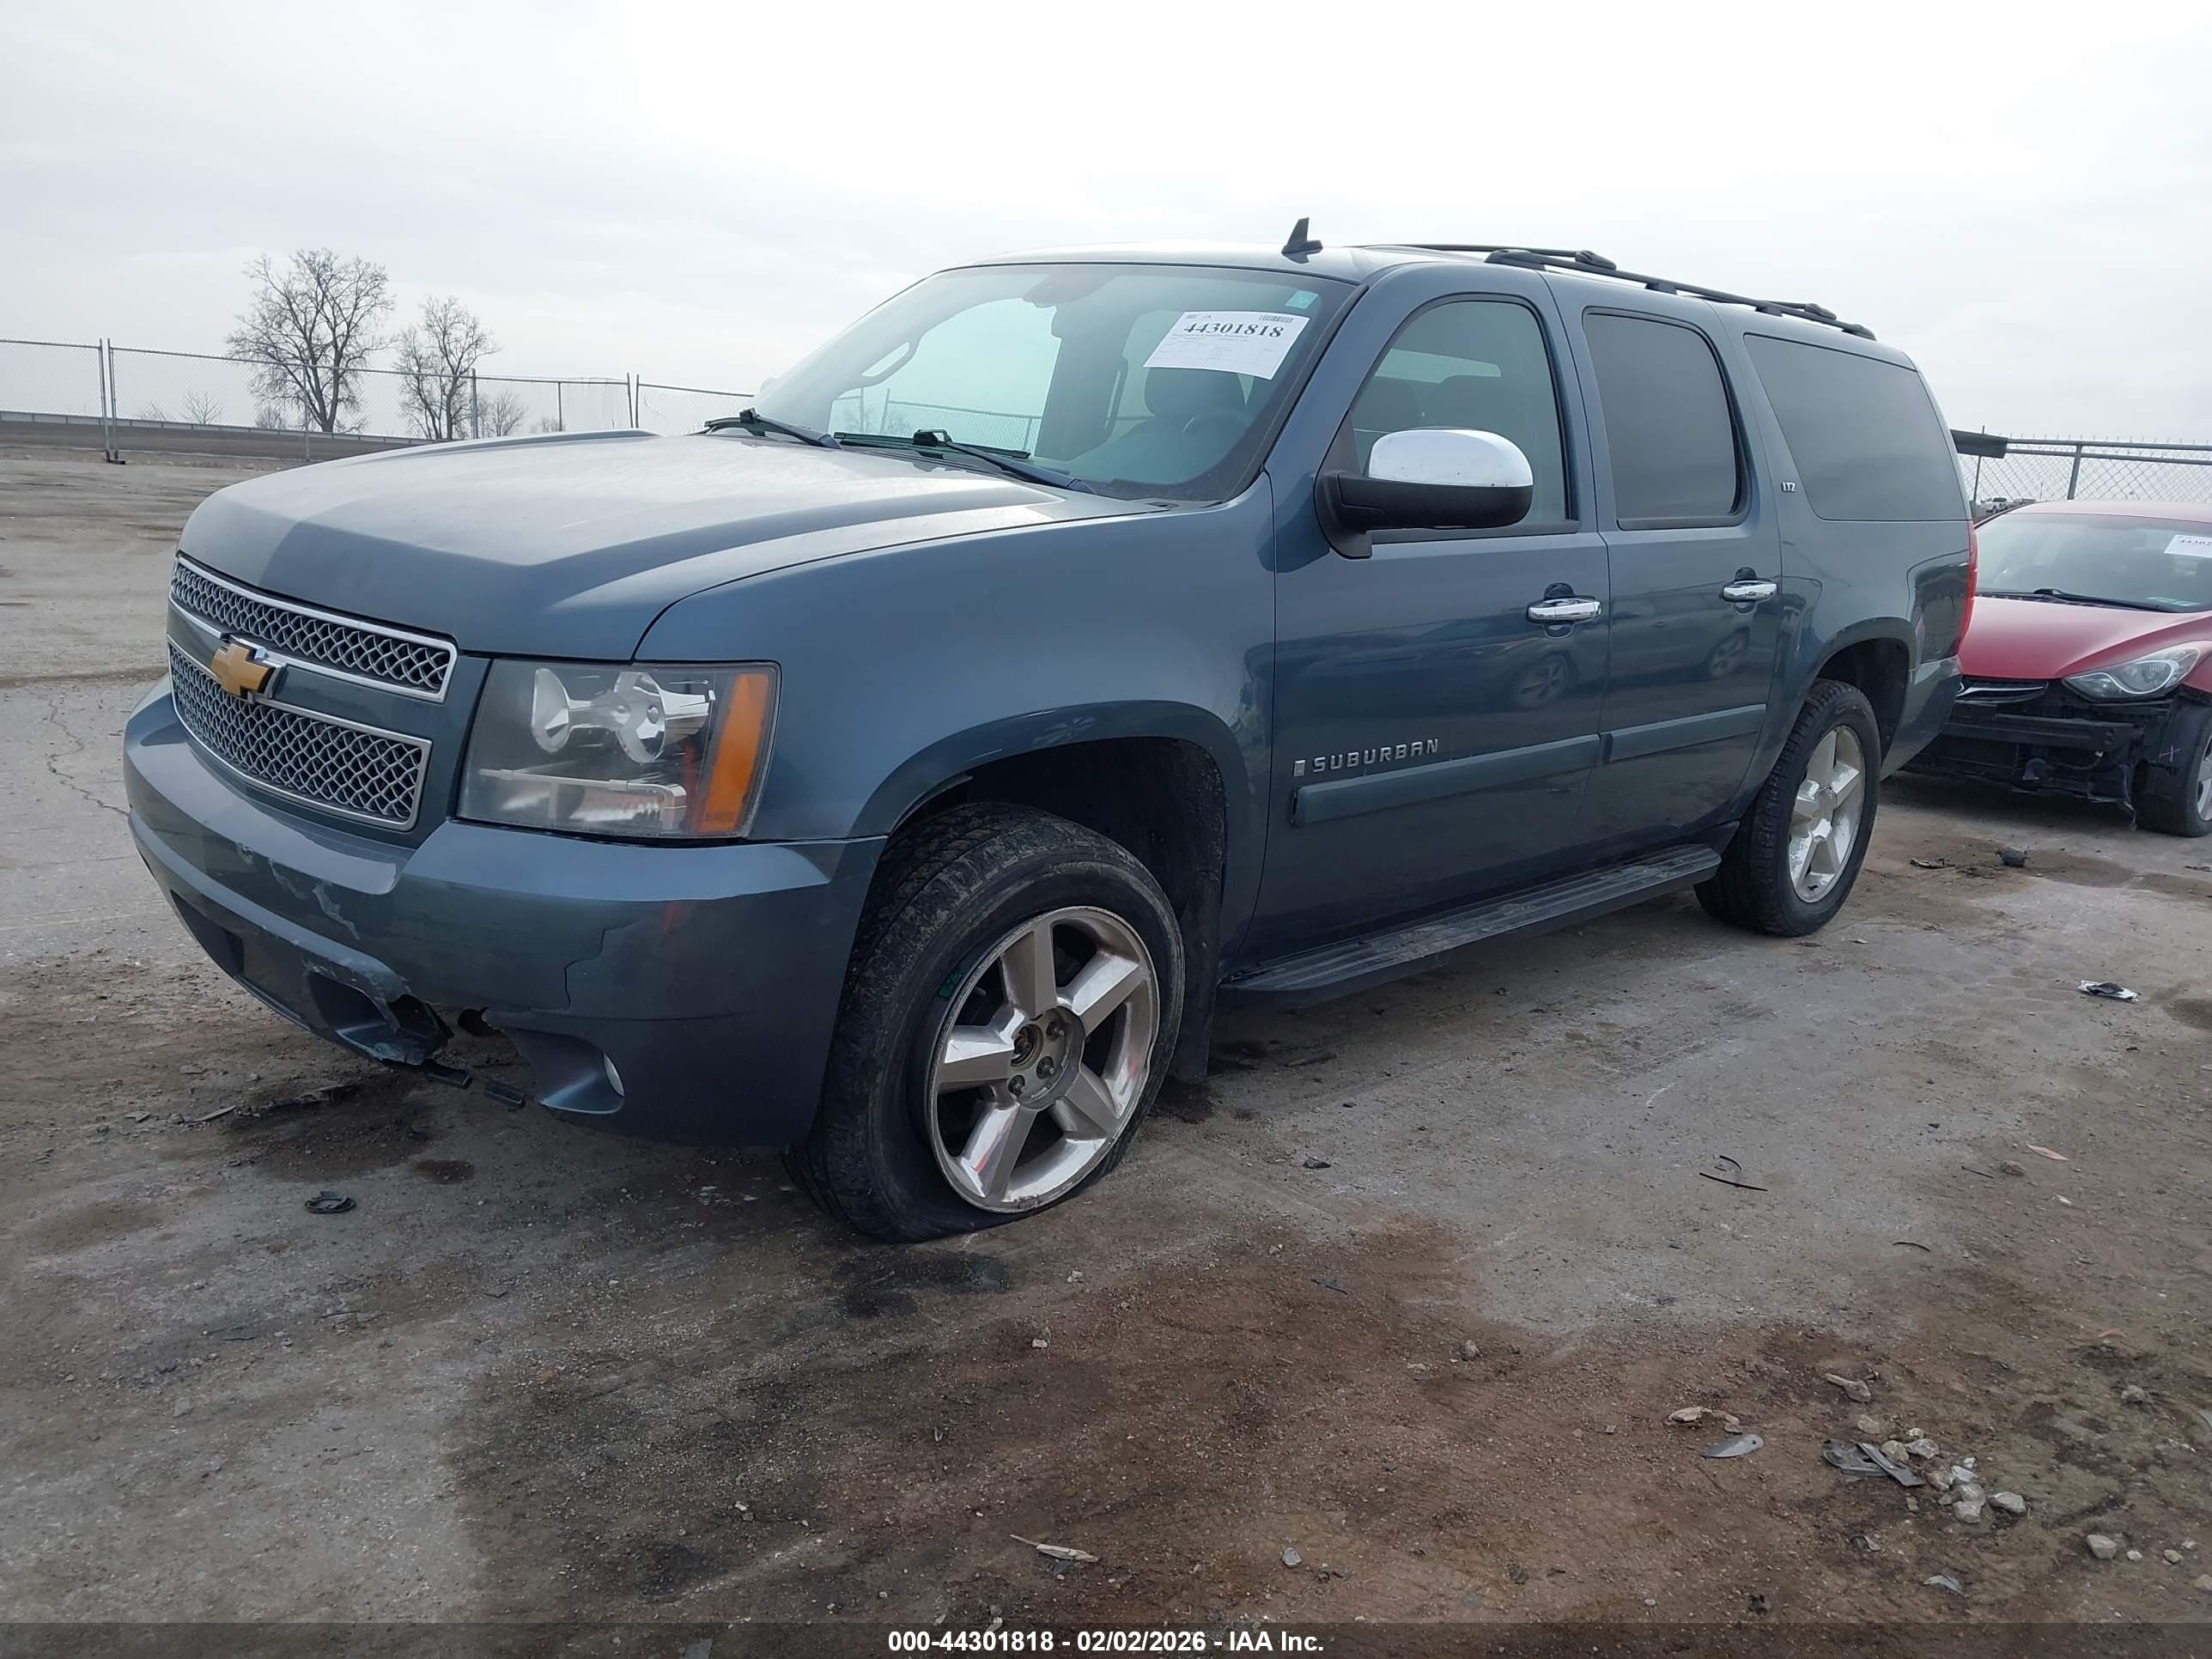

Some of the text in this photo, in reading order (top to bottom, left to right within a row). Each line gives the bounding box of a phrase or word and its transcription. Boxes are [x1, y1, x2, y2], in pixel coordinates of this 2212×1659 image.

[1183, 322, 1284, 337] 44301818
[1782, 481, 1796, 492] LTZ
[1312, 738, 1438, 773] SUBURBAN
